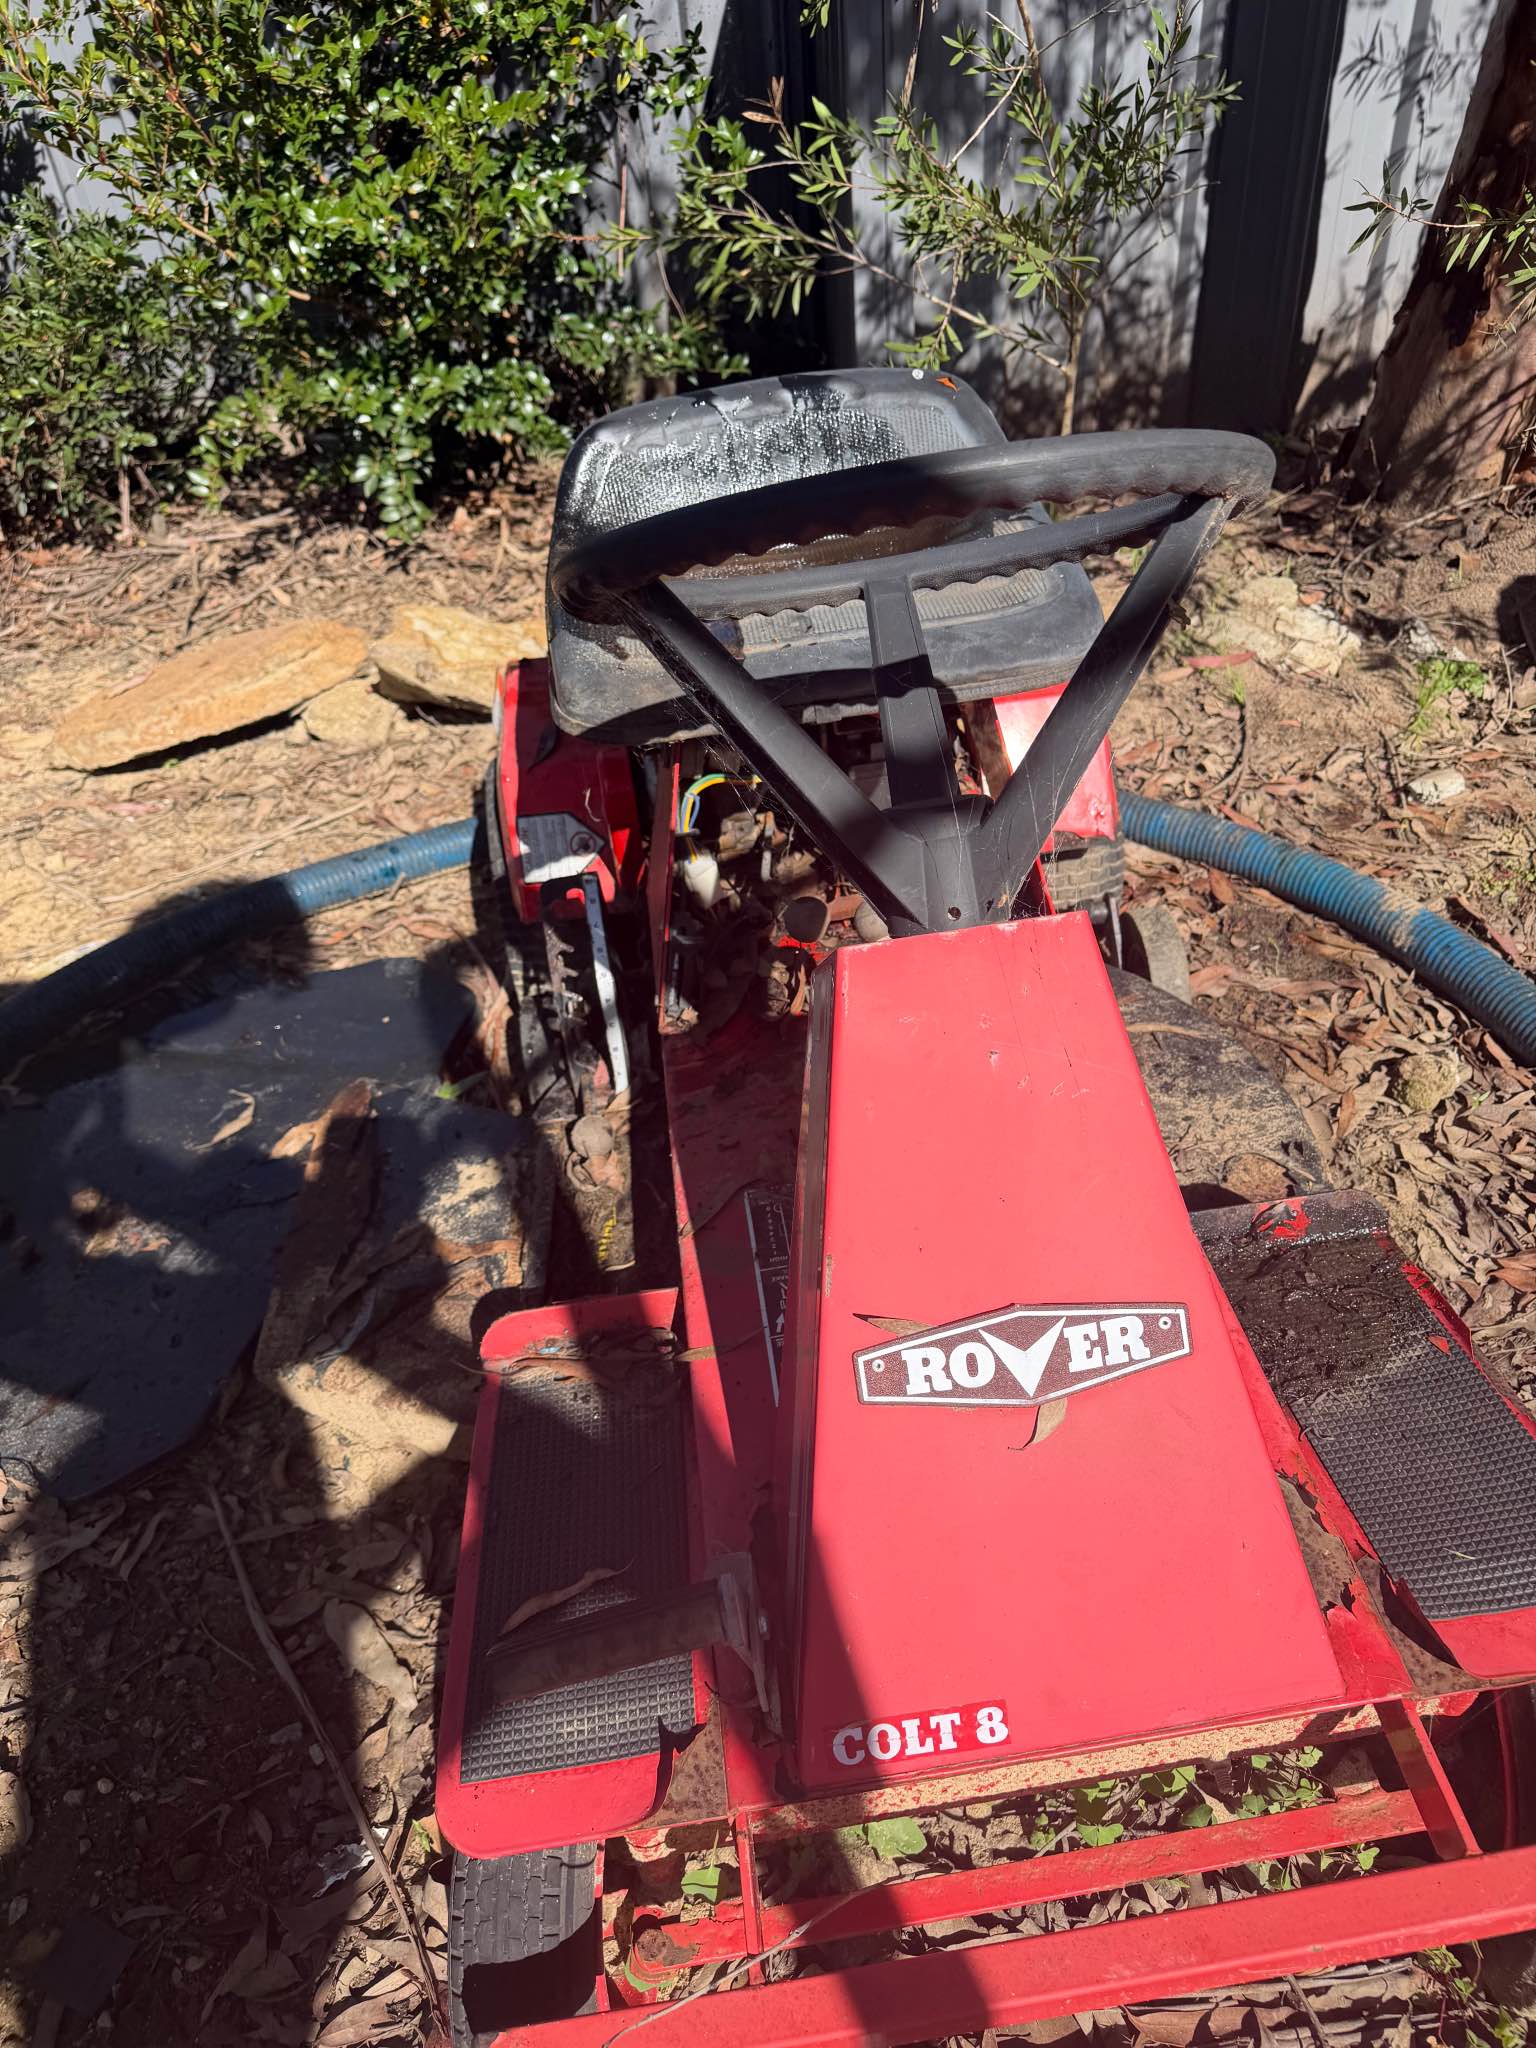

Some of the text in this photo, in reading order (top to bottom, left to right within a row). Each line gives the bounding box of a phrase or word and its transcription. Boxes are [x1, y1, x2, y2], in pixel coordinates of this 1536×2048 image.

[900, 1315, 1151, 1398] ROVER
[832, 1706, 1009, 1766] COLT 8
